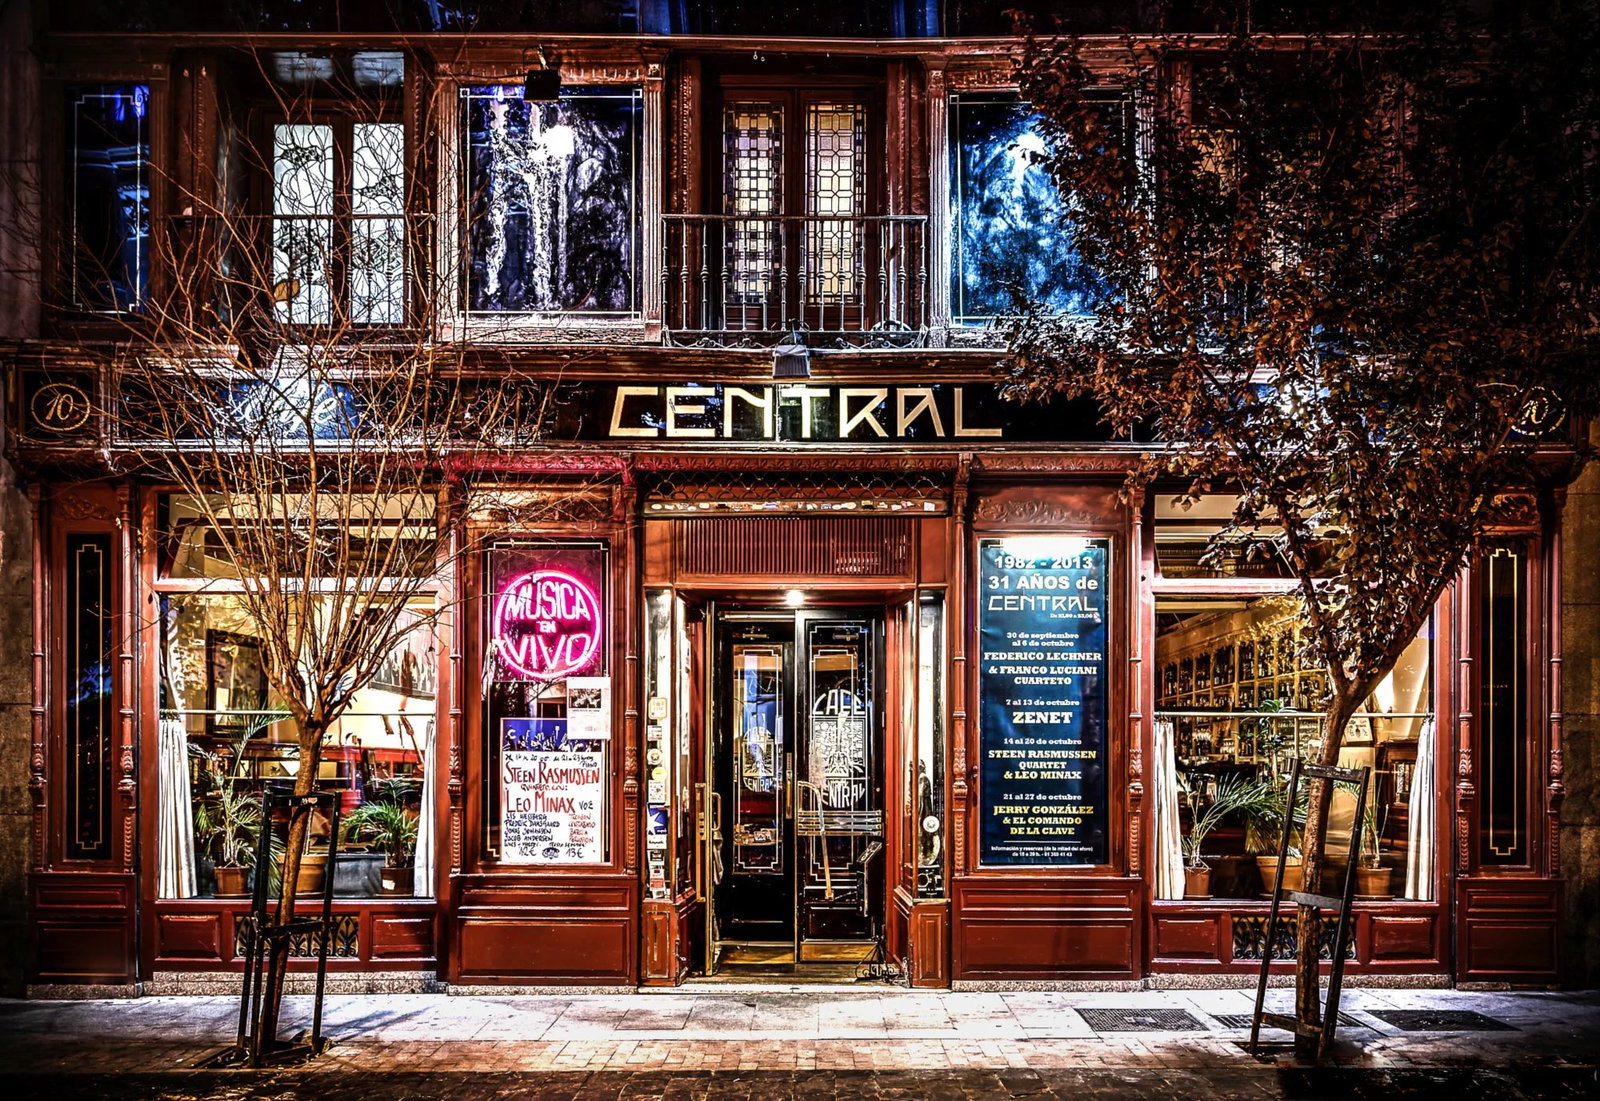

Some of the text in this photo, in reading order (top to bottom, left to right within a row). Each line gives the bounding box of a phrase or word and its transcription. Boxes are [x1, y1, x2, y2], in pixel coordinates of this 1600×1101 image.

[46, 393, 74, 420] 10
[609, 385, 1002, 438] CENTRAL
[994, 556, 1036, 569] 1982
[1051, 556, 1093, 569] 2013
[988, 573, 1099, 590] 31 AÑOS de
[988, 595, 1098, 611] CENTRAL
[1030, 632, 1079, 641] septiembre
[503, 633, 592, 670] VIVO
[984, 652, 1102, 661] FEDERICO LECHNER
[988, 666, 1097, 674] & FRANCO LUCIANI
[1014, 677, 1072, 685] CUARTETO
[1012, 712, 1072, 724] ZENET
[988, 750, 1096, 759] STEEN RASMUSSEN
[1018, 761, 1067, 770] QUARTET
[504, 760, 600, 785] STEEN RASMUSSEN
[1003, 771, 1082, 780] & LEO MINAX
[506, 787, 576, 813] LEO MINAX
[993, 804, 1094, 816] JERRY GONZÁLEZ
[1003, 817, 1082, 825] & EL COMANDO
[1010, 827, 1075, 835] DE LA CLAVE
